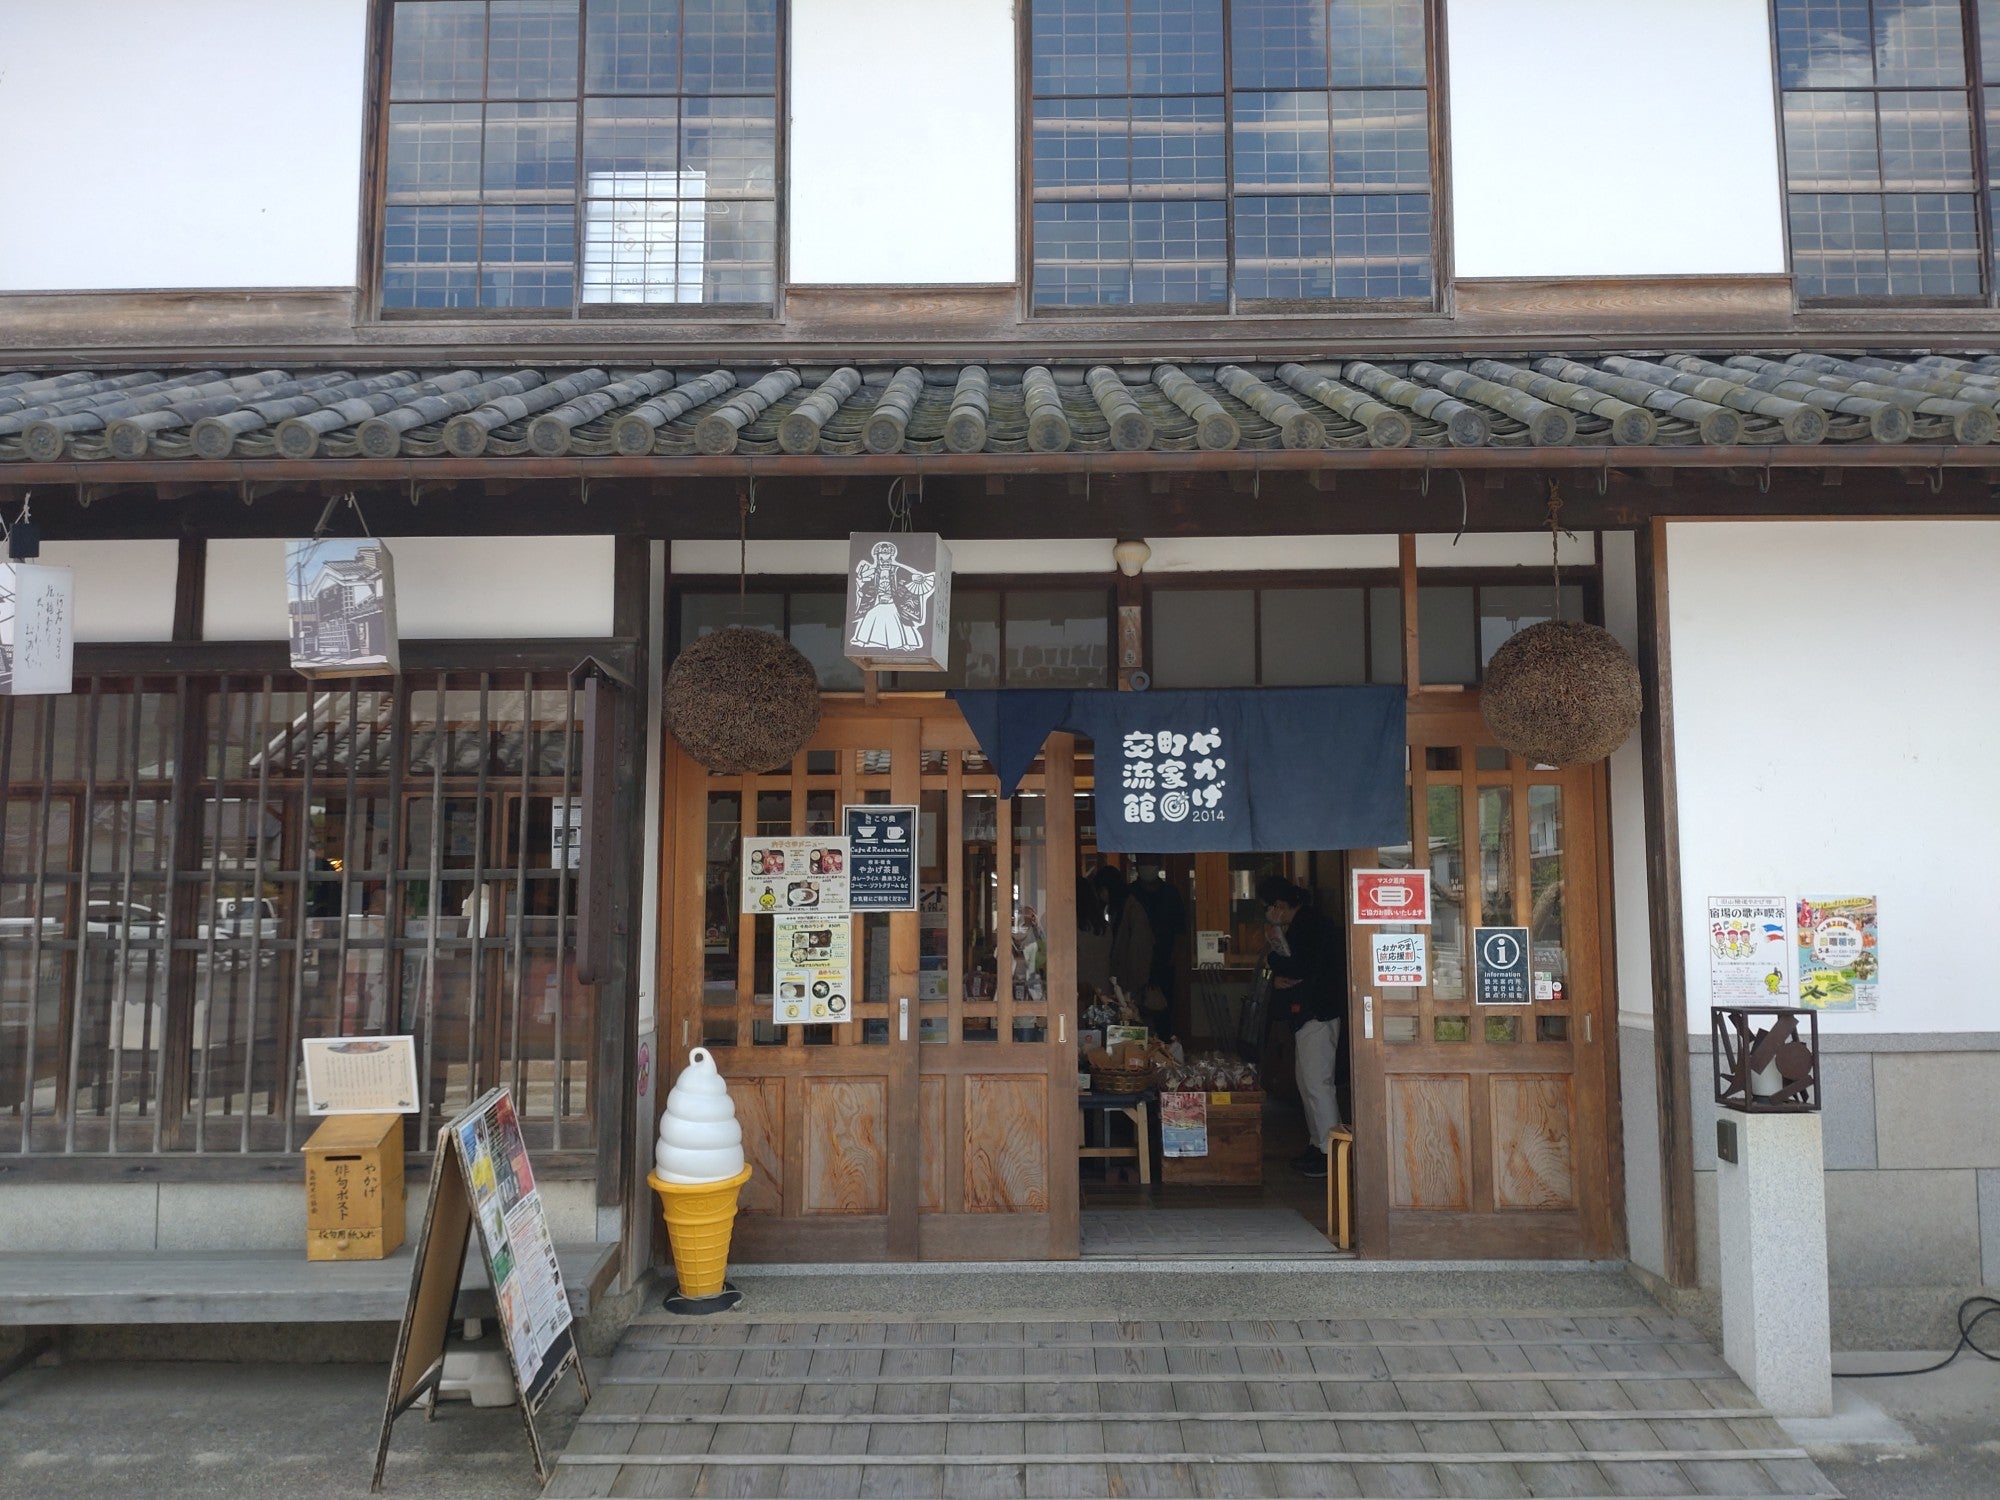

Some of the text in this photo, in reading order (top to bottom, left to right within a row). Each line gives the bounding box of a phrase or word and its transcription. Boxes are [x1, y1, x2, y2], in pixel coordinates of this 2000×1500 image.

[1190, 727, 1226, 808] やかげ
[1122, 731, 1156, 823] 交流館
[1192, 809, 1226, 822] 2014
[858, 866, 900, 874] やかげ茶屋
[1709, 908, 1785, 918] 宿場の歌声喫茶
[1382, 943, 1412, 952] おかやま
[1379, 952, 1414, 961] 旅応援割
[1377, 965, 1422, 973] 観光クーポン券
[364, 1163, 378, 1198] やかげ
[334, 1164, 351, 1221] 俳句ポスト
